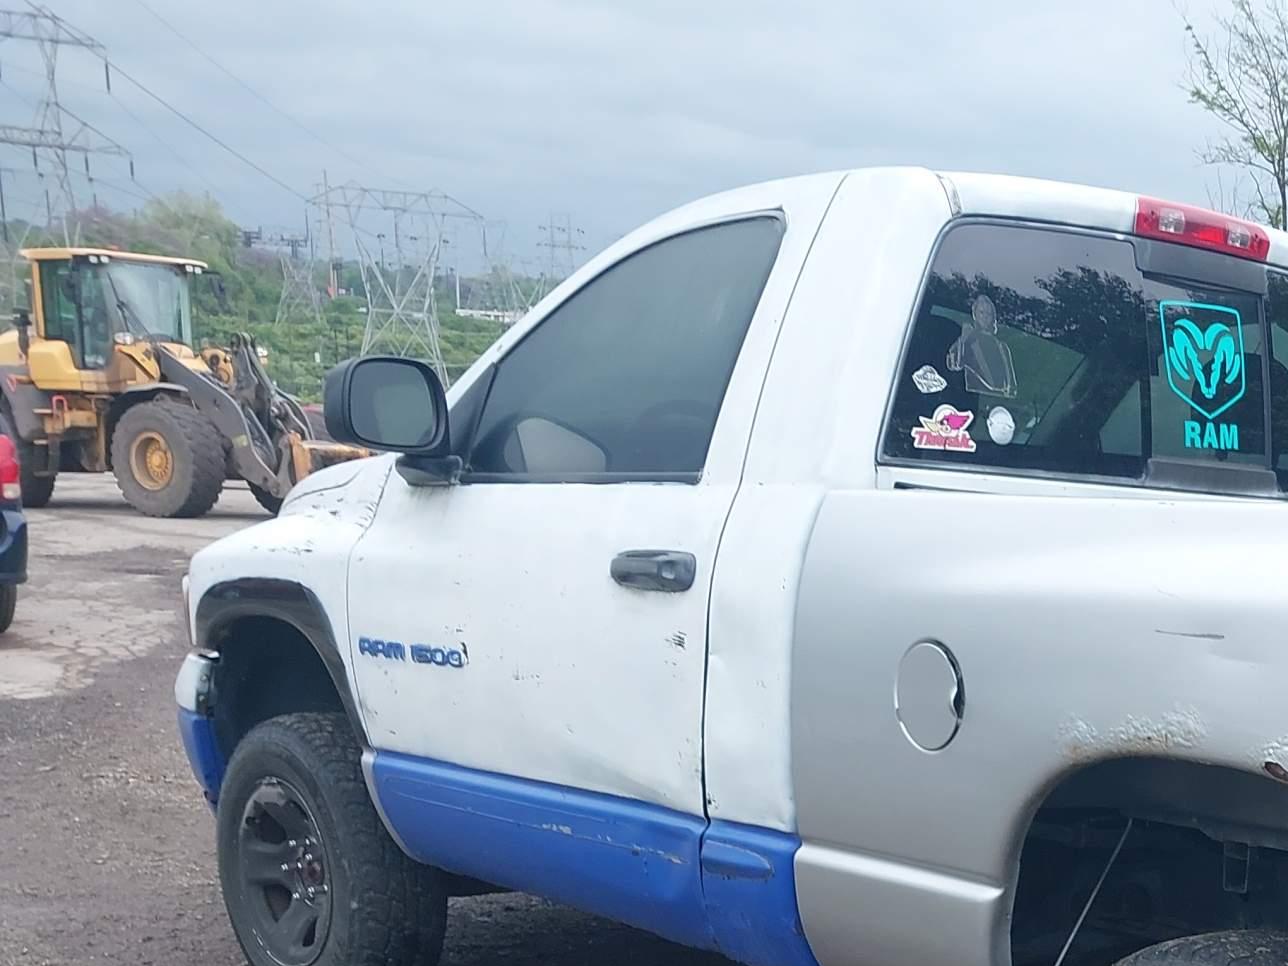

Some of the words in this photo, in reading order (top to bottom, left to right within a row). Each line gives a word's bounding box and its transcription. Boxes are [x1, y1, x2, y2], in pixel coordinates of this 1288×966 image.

[1183, 420, 1240, 451] RAM
[358, 636, 406, 662] RAM
[409, 643, 465, 669] 1500
